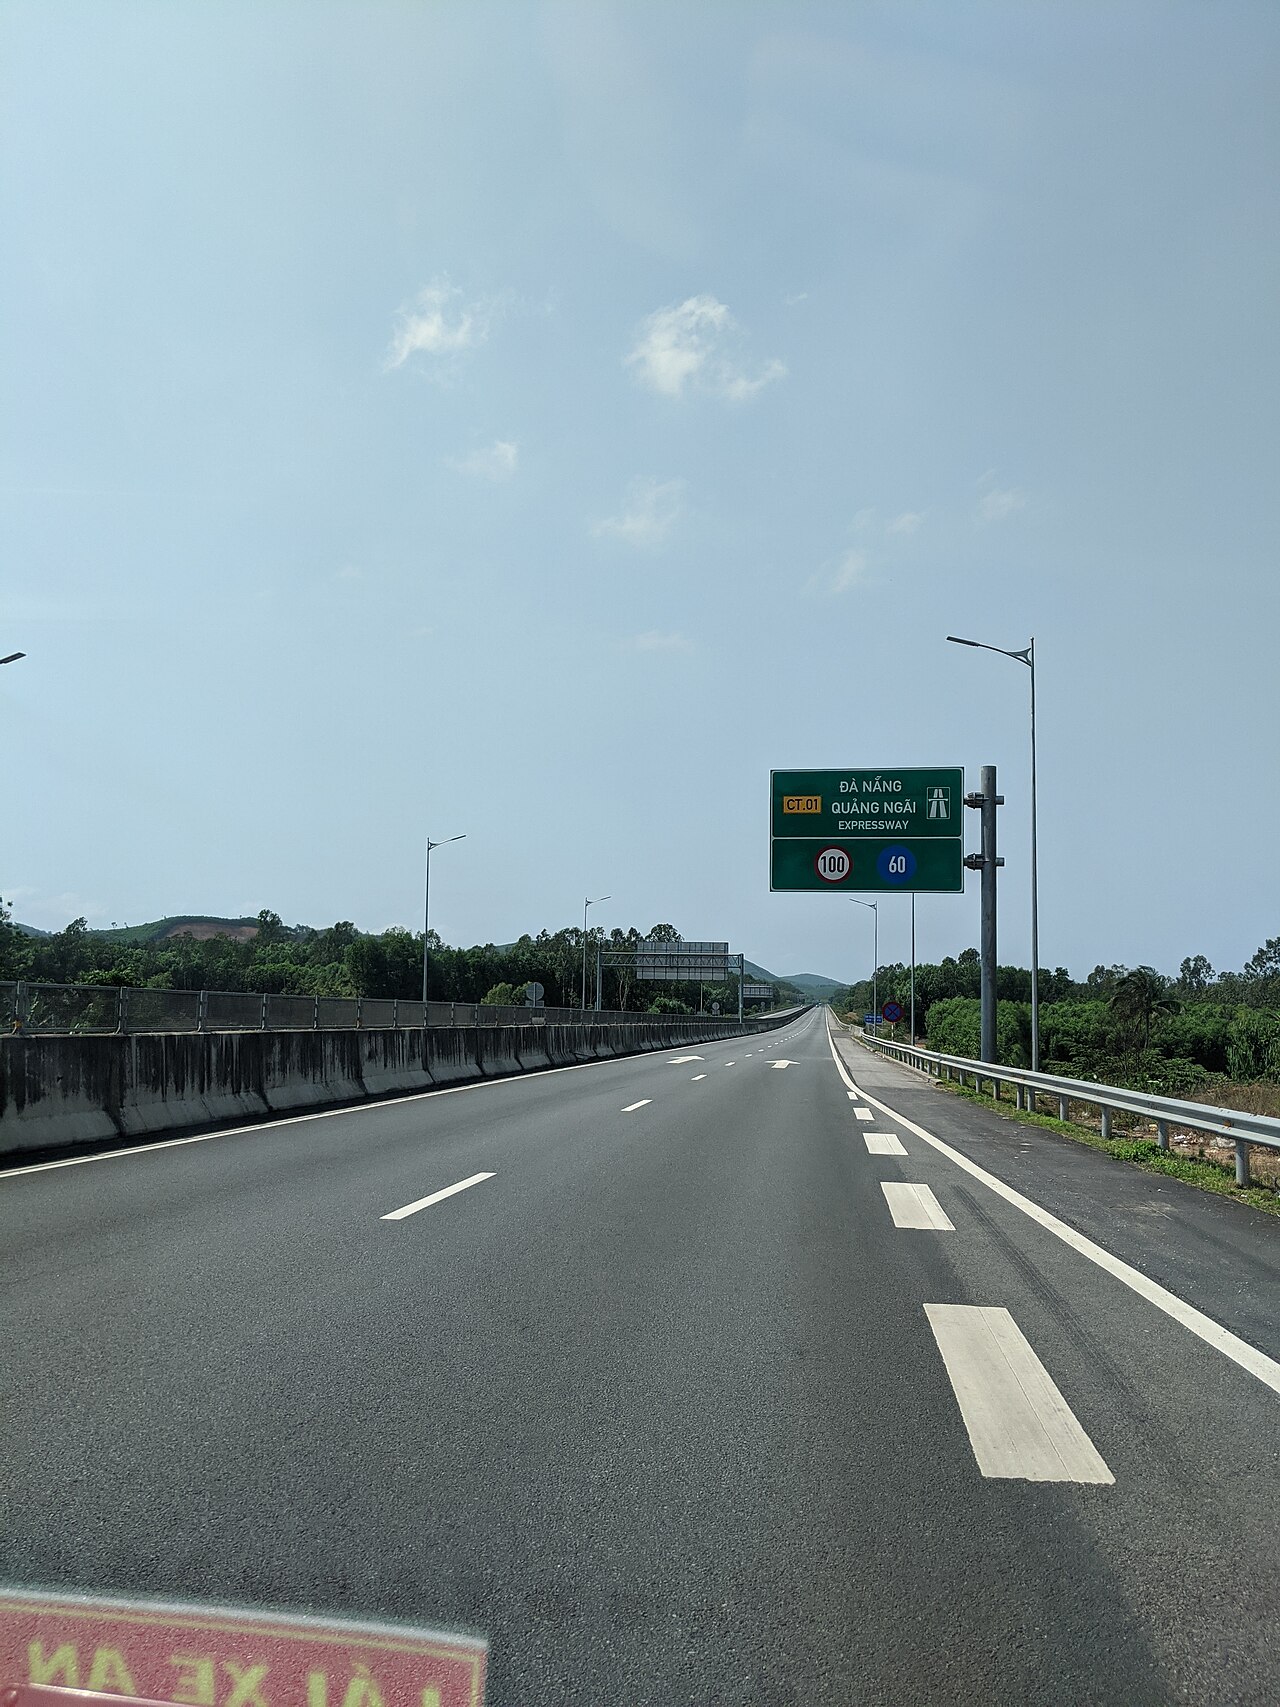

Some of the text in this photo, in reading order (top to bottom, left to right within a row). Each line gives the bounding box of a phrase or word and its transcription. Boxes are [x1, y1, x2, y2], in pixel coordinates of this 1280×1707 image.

[839, 777, 859, 793] ĐÀ
[786, 798, 819, 811] CT.01
[831, 797, 916, 814] QUẢNG NGÃI
[838, 820, 909, 830] EXPRESSWAY
[820, 855, 845, 873] 100
[888, 855, 906, 873] 60
